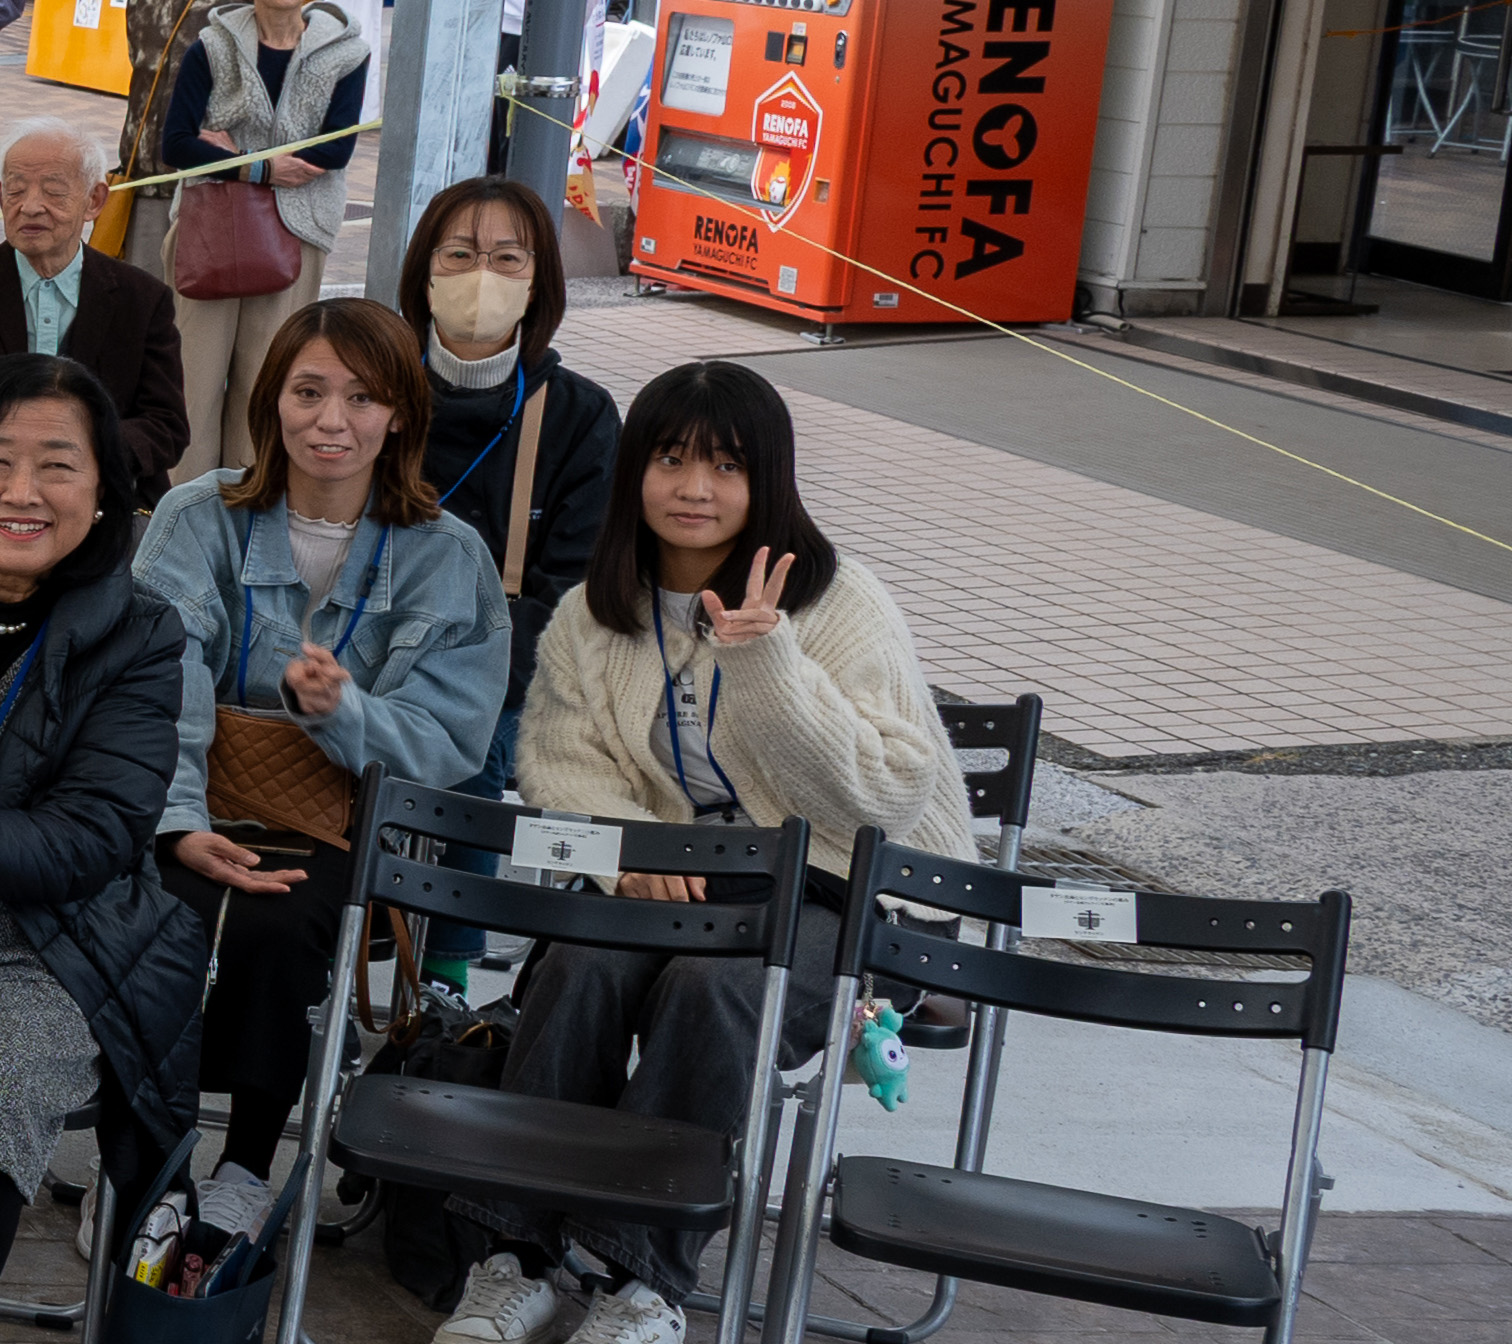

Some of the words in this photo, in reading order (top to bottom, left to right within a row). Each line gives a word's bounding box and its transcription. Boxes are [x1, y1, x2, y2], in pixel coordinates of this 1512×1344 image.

[762, 112, 809, 140] RENOFA
[761, 132, 799, 149] YAMAGUCHI
[693, 214, 760, 255] RENOFA
[693, 243, 745, 267] YAMAGUCHI
[744, 256, 759, 271] FC
[909, 226, 950, 281] FC
